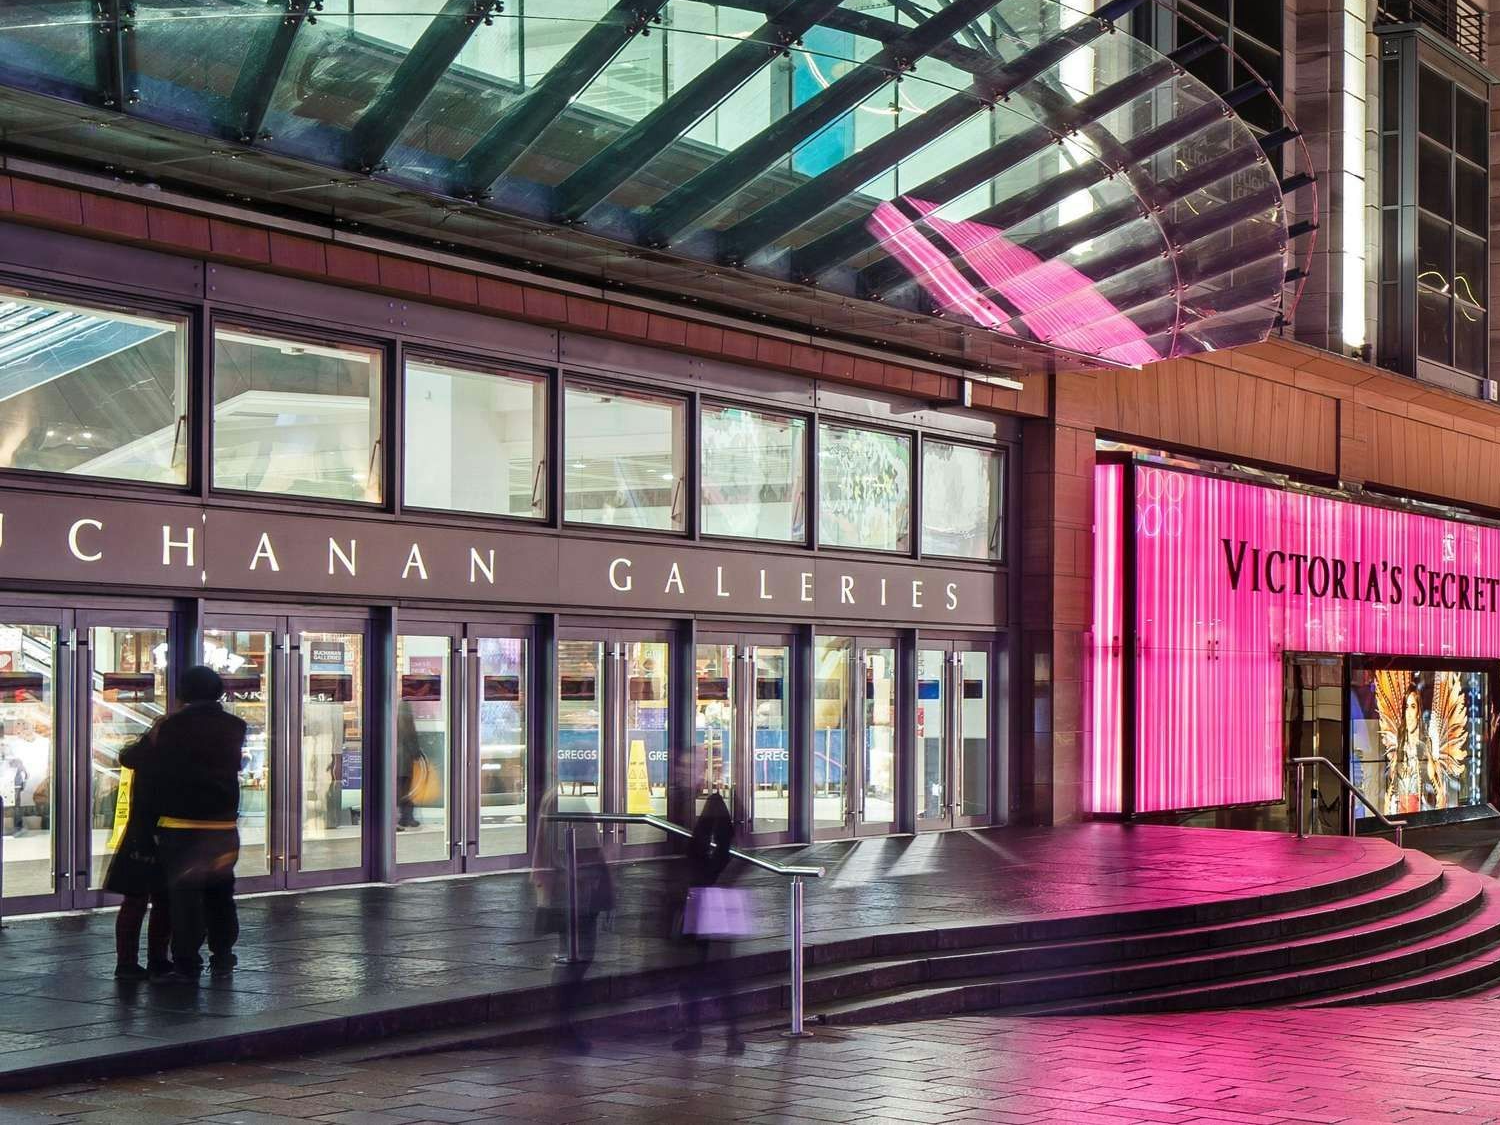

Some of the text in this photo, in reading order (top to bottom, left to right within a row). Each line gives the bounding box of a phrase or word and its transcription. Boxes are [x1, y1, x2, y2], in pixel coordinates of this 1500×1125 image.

[0, 513, 958, 611] CHANAN GALLERIES
[557, 750, 597, 760] GREGGS
